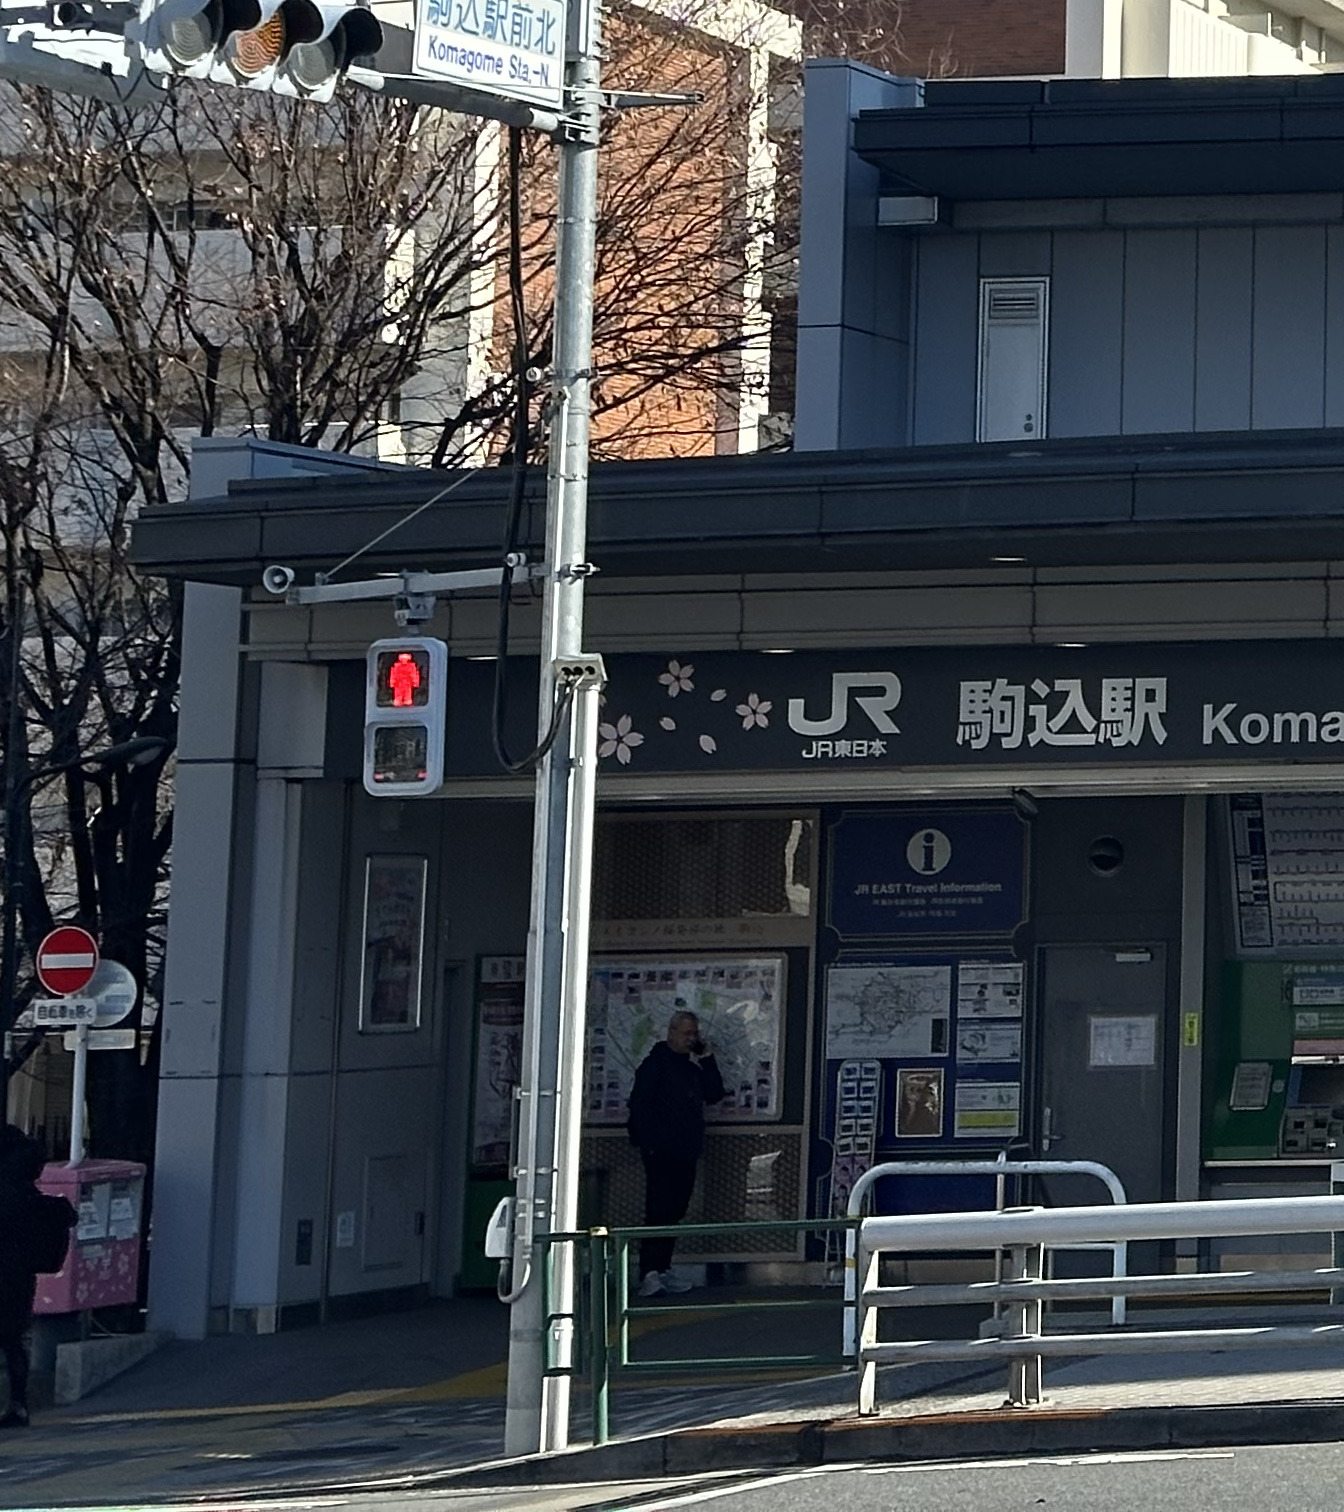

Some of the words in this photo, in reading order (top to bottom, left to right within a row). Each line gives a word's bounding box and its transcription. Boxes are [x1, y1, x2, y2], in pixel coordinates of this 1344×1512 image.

[427, 35, 504, 75] Komagome
[788, 671, 902, 737] JR
[955, 676, 1168, 750] 駒込駅
[801, 738, 887, 758] JR東日本
